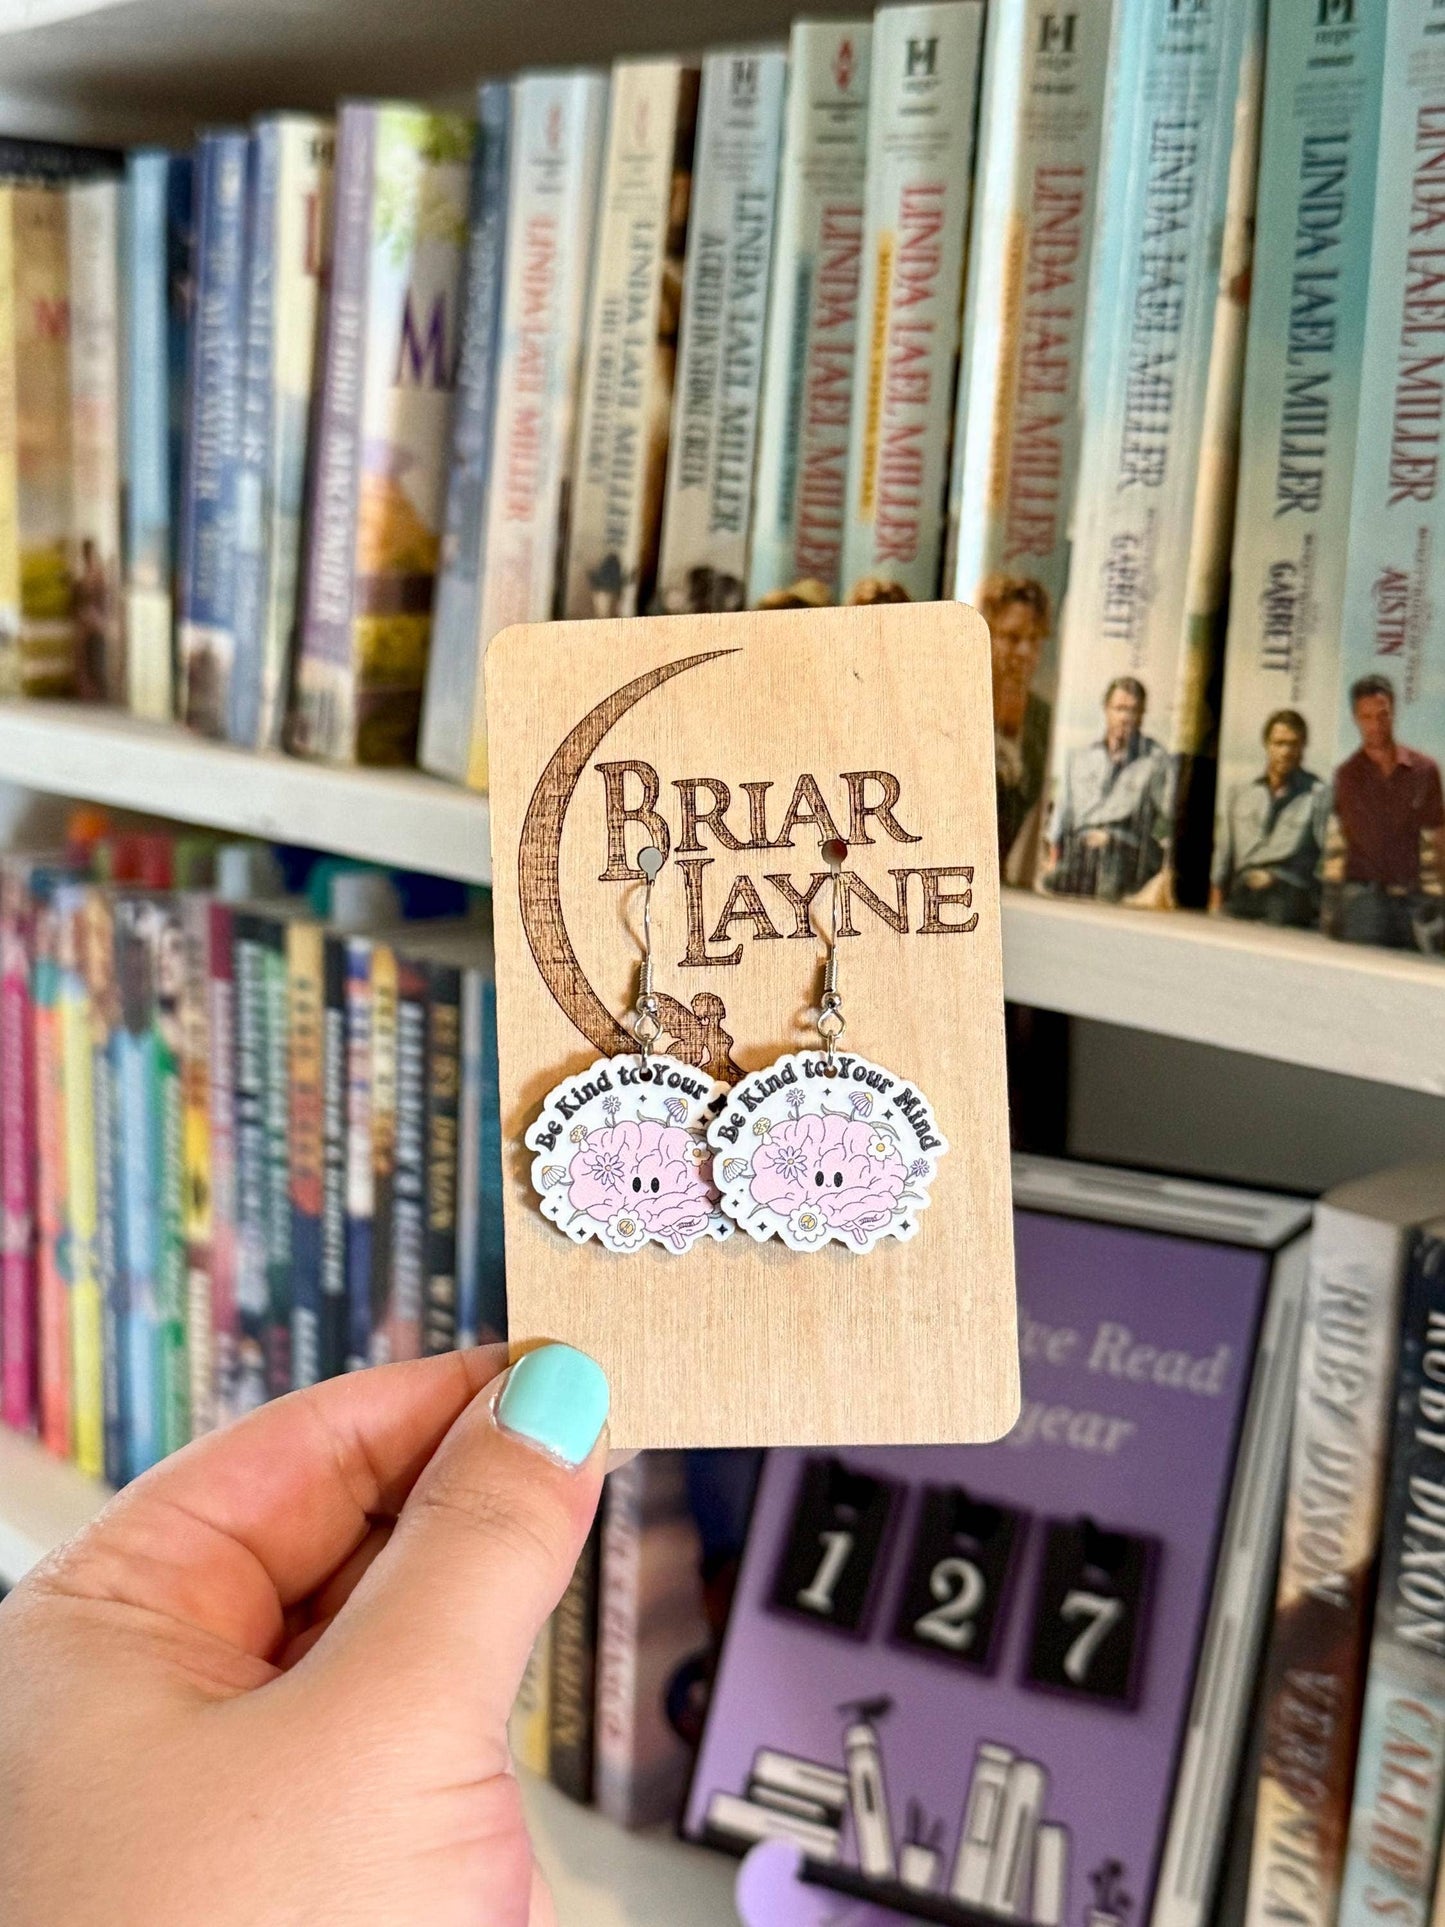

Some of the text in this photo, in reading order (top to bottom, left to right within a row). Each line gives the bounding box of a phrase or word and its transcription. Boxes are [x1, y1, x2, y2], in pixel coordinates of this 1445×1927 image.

[1028, 166, 1085, 295] LINDA
[1142, 118, 1198, 243] LINDA
[1296, 132, 1350, 259] LINDA
[1409, 103, 1445, 237] LINDA
[728, 189, 766, 300] LINDA
[816, 206, 863, 329] LINDA
[895, 183, 946, 306] LINDA
[1133, 252, 1186, 350] LAEL
[1401, 247, 1445, 347] LAEL
[886, 320, 935, 416] LAEL
[1018, 308, 1074, 405] LAEL
[1287, 270, 1340, 366] LAEL
[806, 342, 855, 437] LAEL
[1117, 352, 1175, 493] MILLER
[1274, 371, 1332, 519] MILLER
[1388, 353, 1445, 508] MILLER
[710, 405, 749, 534] MILLER
[797, 446, 848, 582] MILLER
[875, 424, 927, 562] MILLER
[1004, 414, 1064, 561] MILLER
[1262, 561, 1297, 672] GARRETT
[1373, 564, 1409, 658] AUSTIN
[594, 759, 923, 881] BRIAR
[673, 858, 980, 968] LAYNE
[535, 1120, 563, 1152] Be
[554, 1069, 614, 1121] Kind
[652, 1062, 709, 1100] Your
[717, 1112, 746, 1144] Be
[737, 1062, 799, 1112] Kind
[838, 1056, 894, 1094] Your
[892, 1087, 942, 1151] Mind
[1089, 1320, 1232, 1396] Read
[1004, 1401, 1138, 1455] year
[1292, 1277, 1368, 1610] RUBY DIXON
[799, 1531, 1126, 1681] 1 2 7
[1394, 1474, 1445, 1652] DIXON
